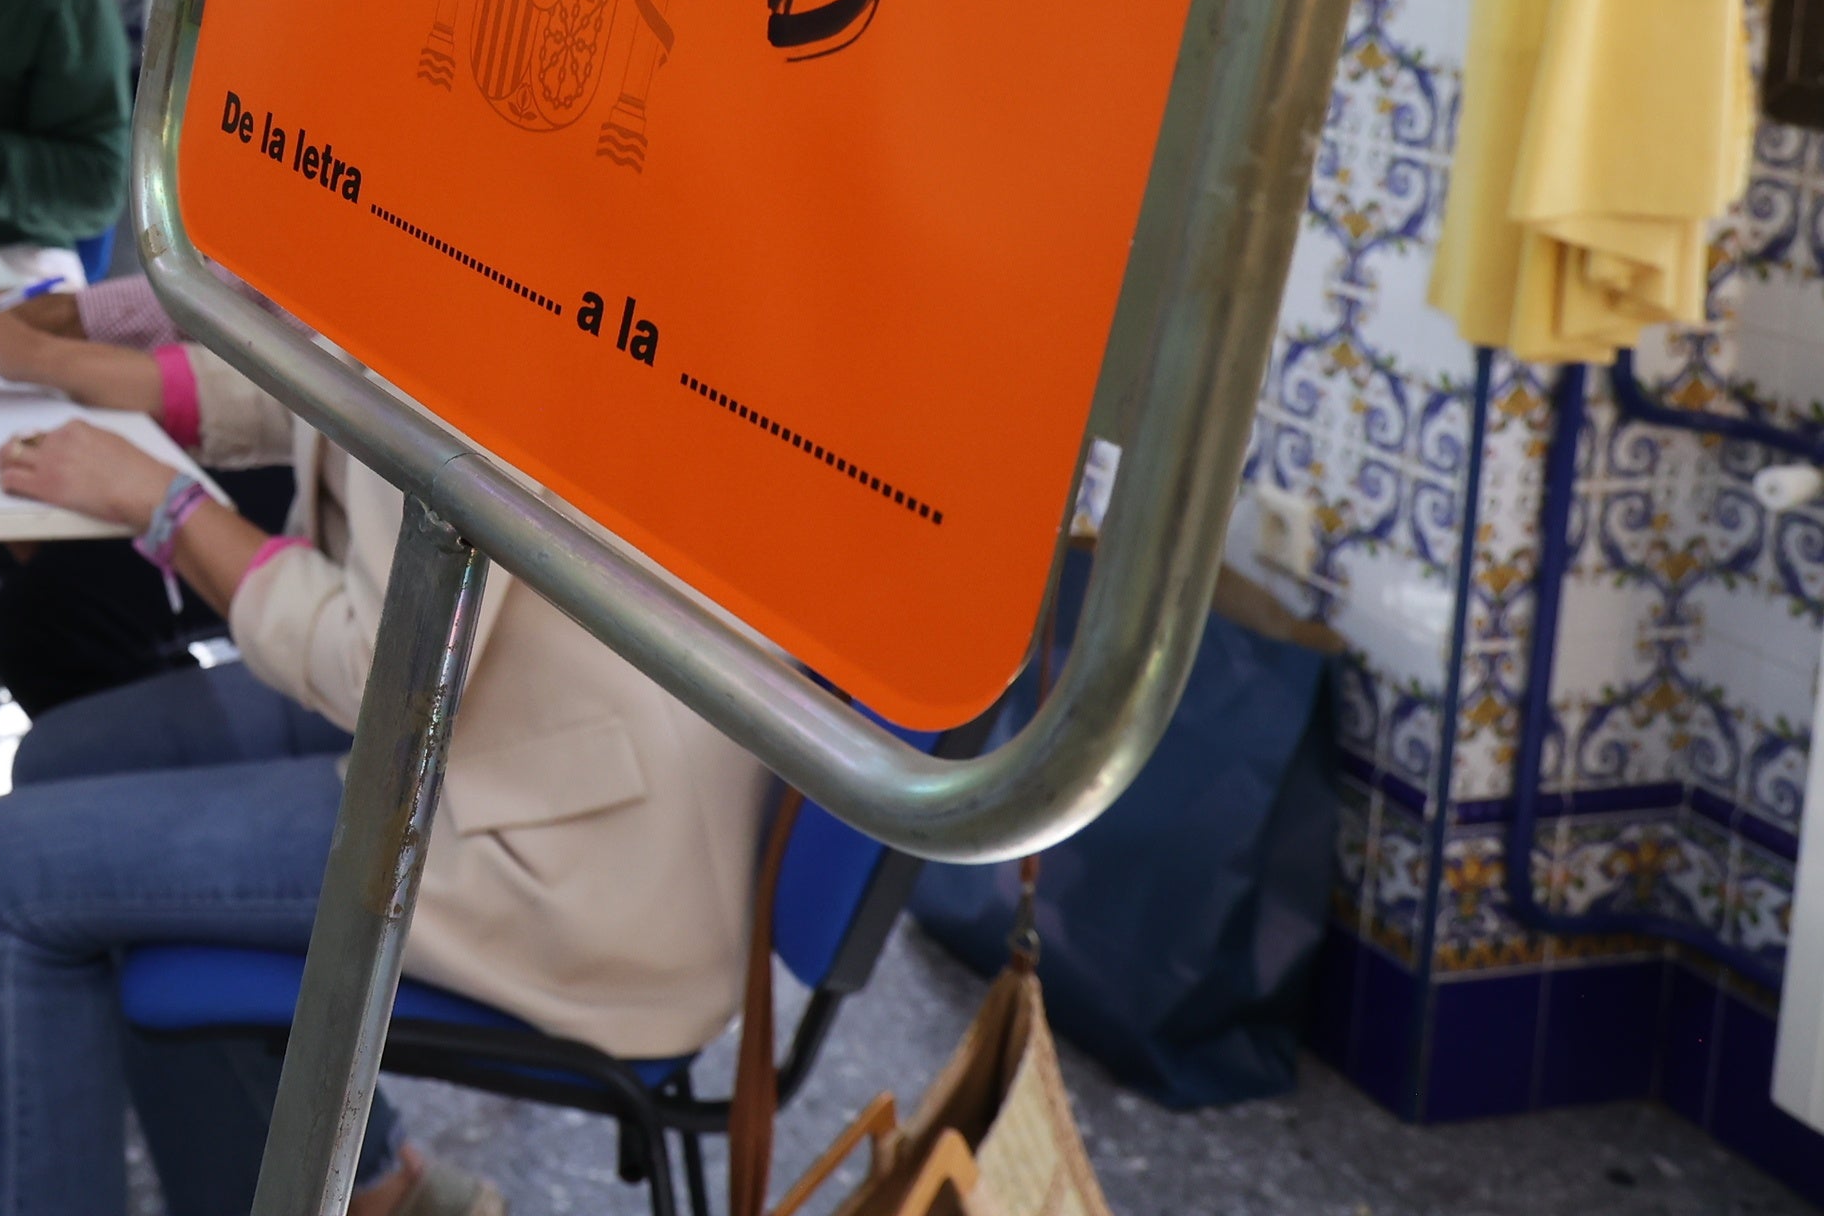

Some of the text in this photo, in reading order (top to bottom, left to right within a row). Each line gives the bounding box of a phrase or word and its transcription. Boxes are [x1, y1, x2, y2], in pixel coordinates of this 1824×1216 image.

[221, 90, 660, 368] De la letra a la
